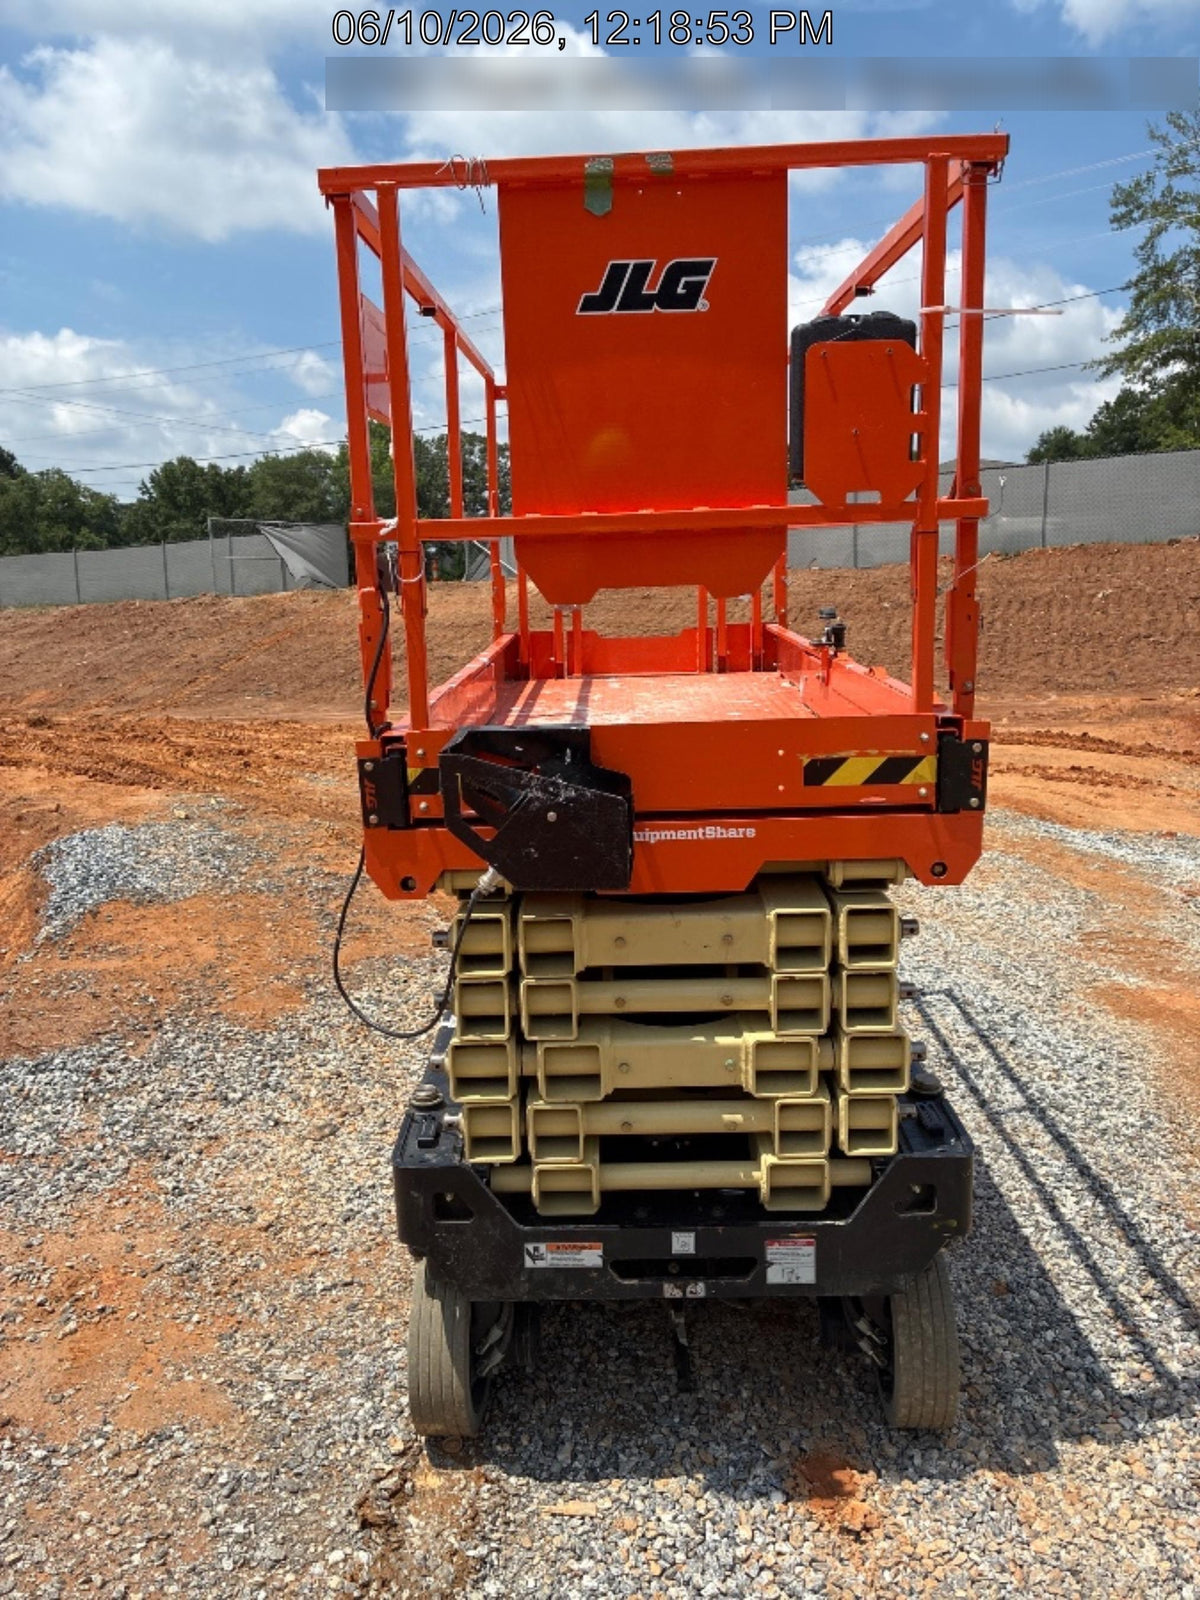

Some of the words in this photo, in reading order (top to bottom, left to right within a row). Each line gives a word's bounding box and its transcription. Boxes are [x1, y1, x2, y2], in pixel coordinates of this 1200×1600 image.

[972, 759, 982, 790] JLG
[364, 777, 377, 809] JLG
[633, 826, 756, 843] uipmentShare
